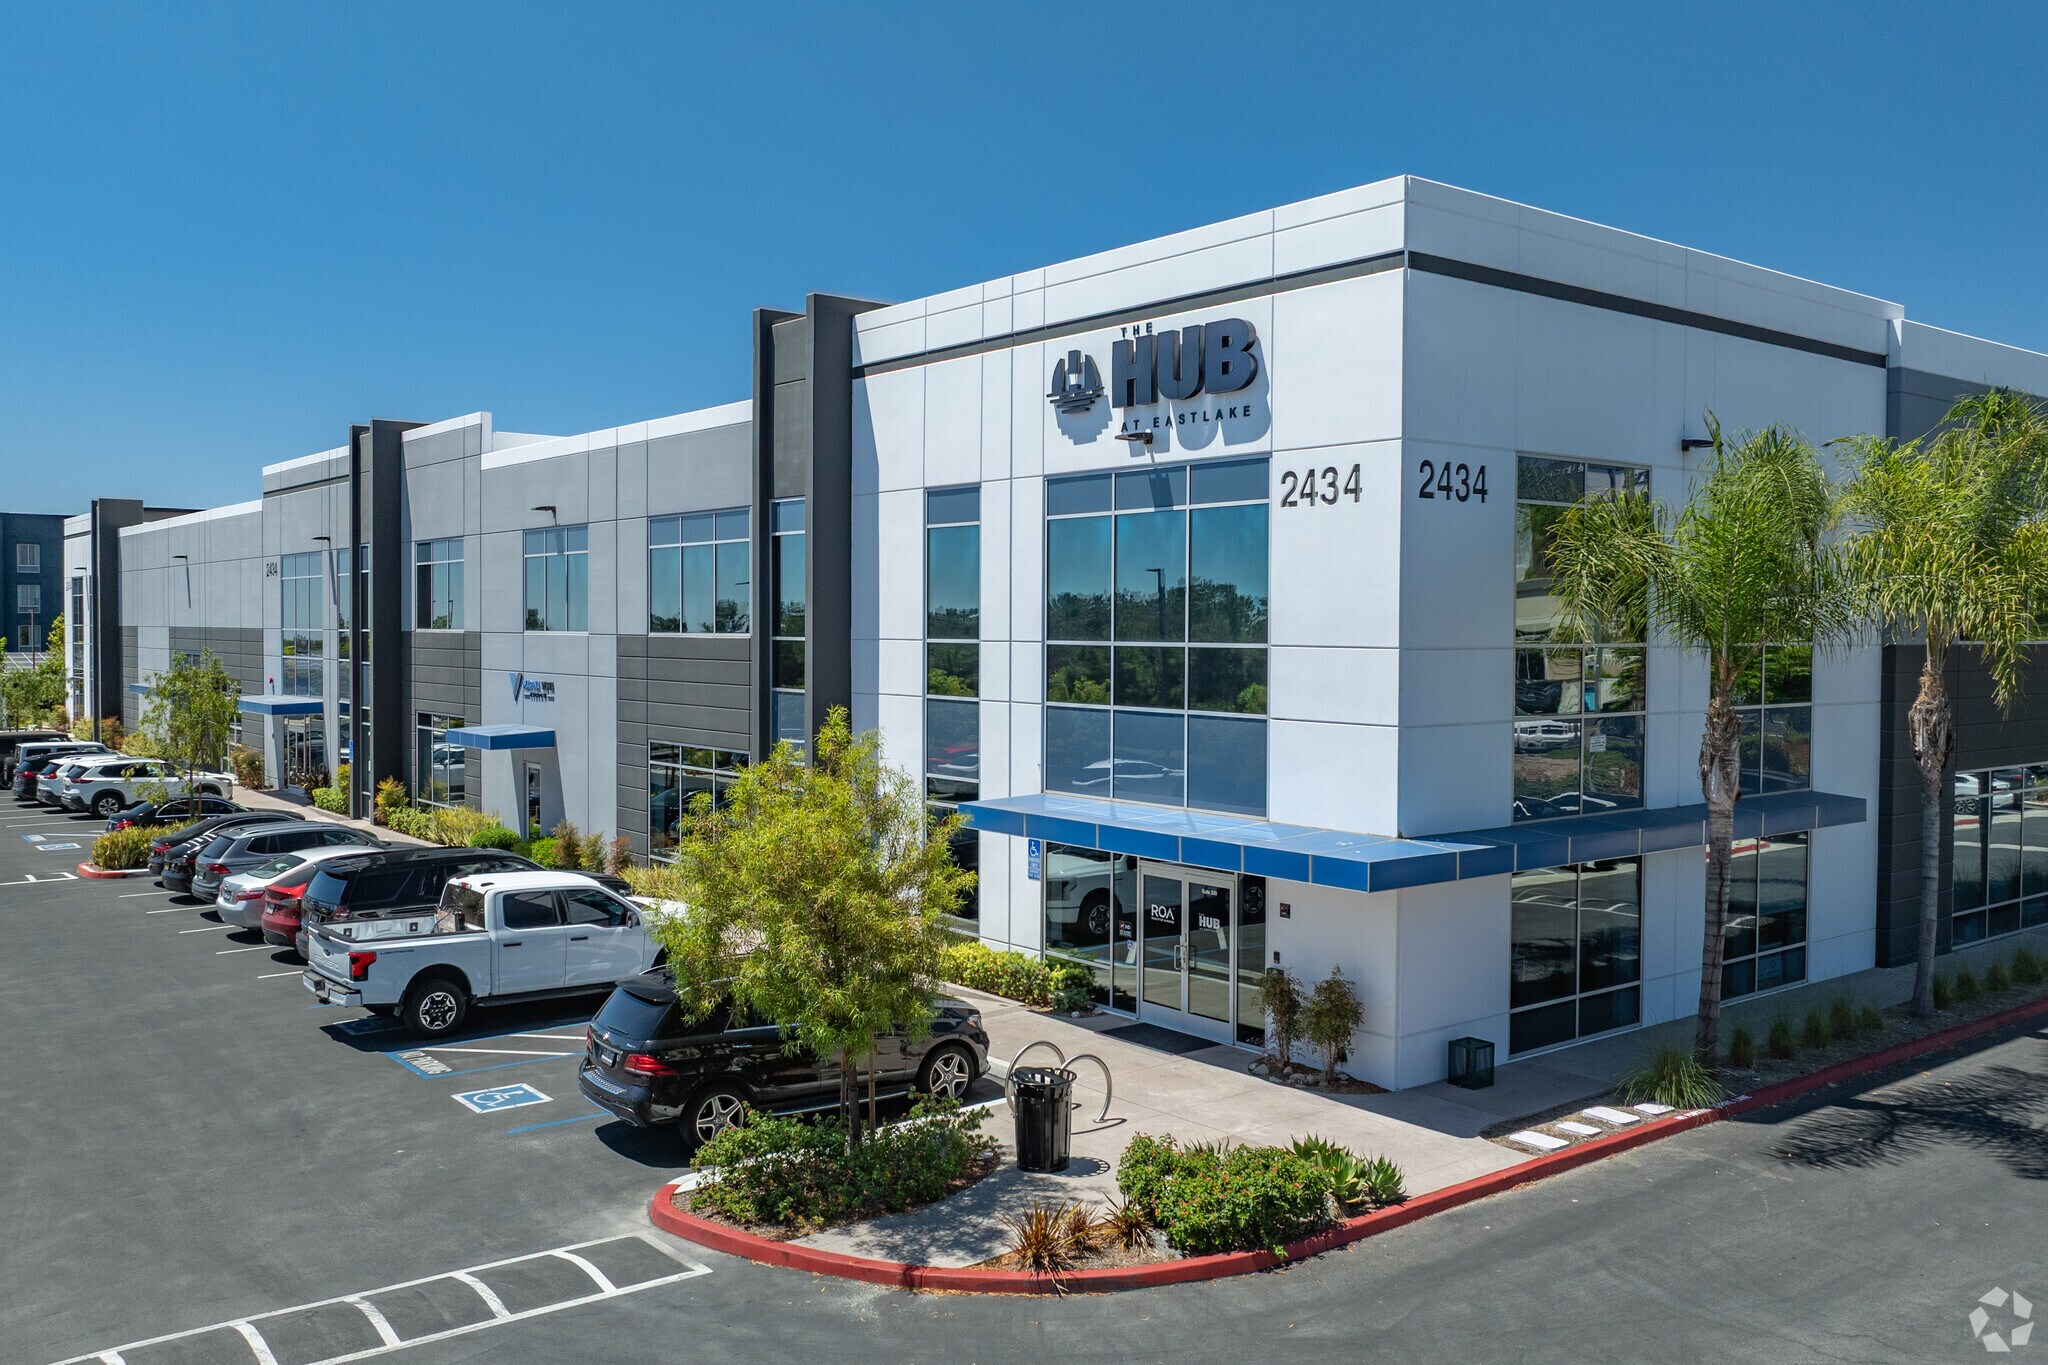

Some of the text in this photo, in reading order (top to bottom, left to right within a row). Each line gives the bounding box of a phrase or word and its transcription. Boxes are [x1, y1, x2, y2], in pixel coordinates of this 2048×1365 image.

[1120, 322, 1153, 339] THE
[1112, 318, 1258, 408] HUB
[1121, 405, 1251, 432] AT EASTLAKE
[1280, 463, 1363, 508] 2434
[1418, 459, 1489, 504] 2434
[266, 562, 278, 577] 2434
[1151, 904, 1175, 920] ROA
[1198, 915, 1221, 929] HUB
